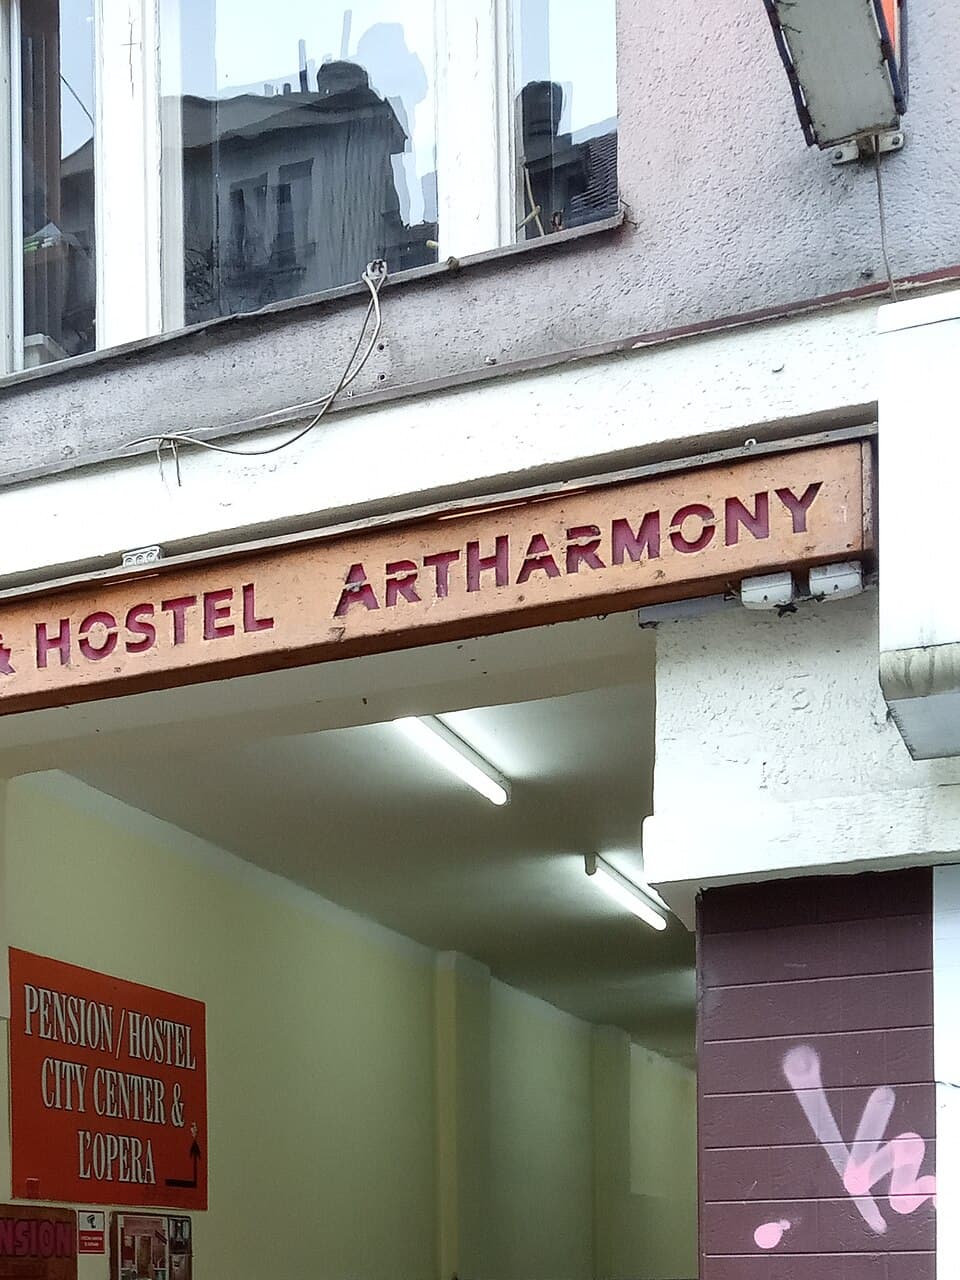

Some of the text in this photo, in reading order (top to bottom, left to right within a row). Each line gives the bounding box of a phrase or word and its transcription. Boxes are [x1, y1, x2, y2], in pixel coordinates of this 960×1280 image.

[35, 583, 274, 669] HOSTEL
[333, 482, 823, 618] ARTHARMONY
[41, 1057, 184, 1127] CITY CENTER &
[78, 1131, 156, 1185] L'OPERA
